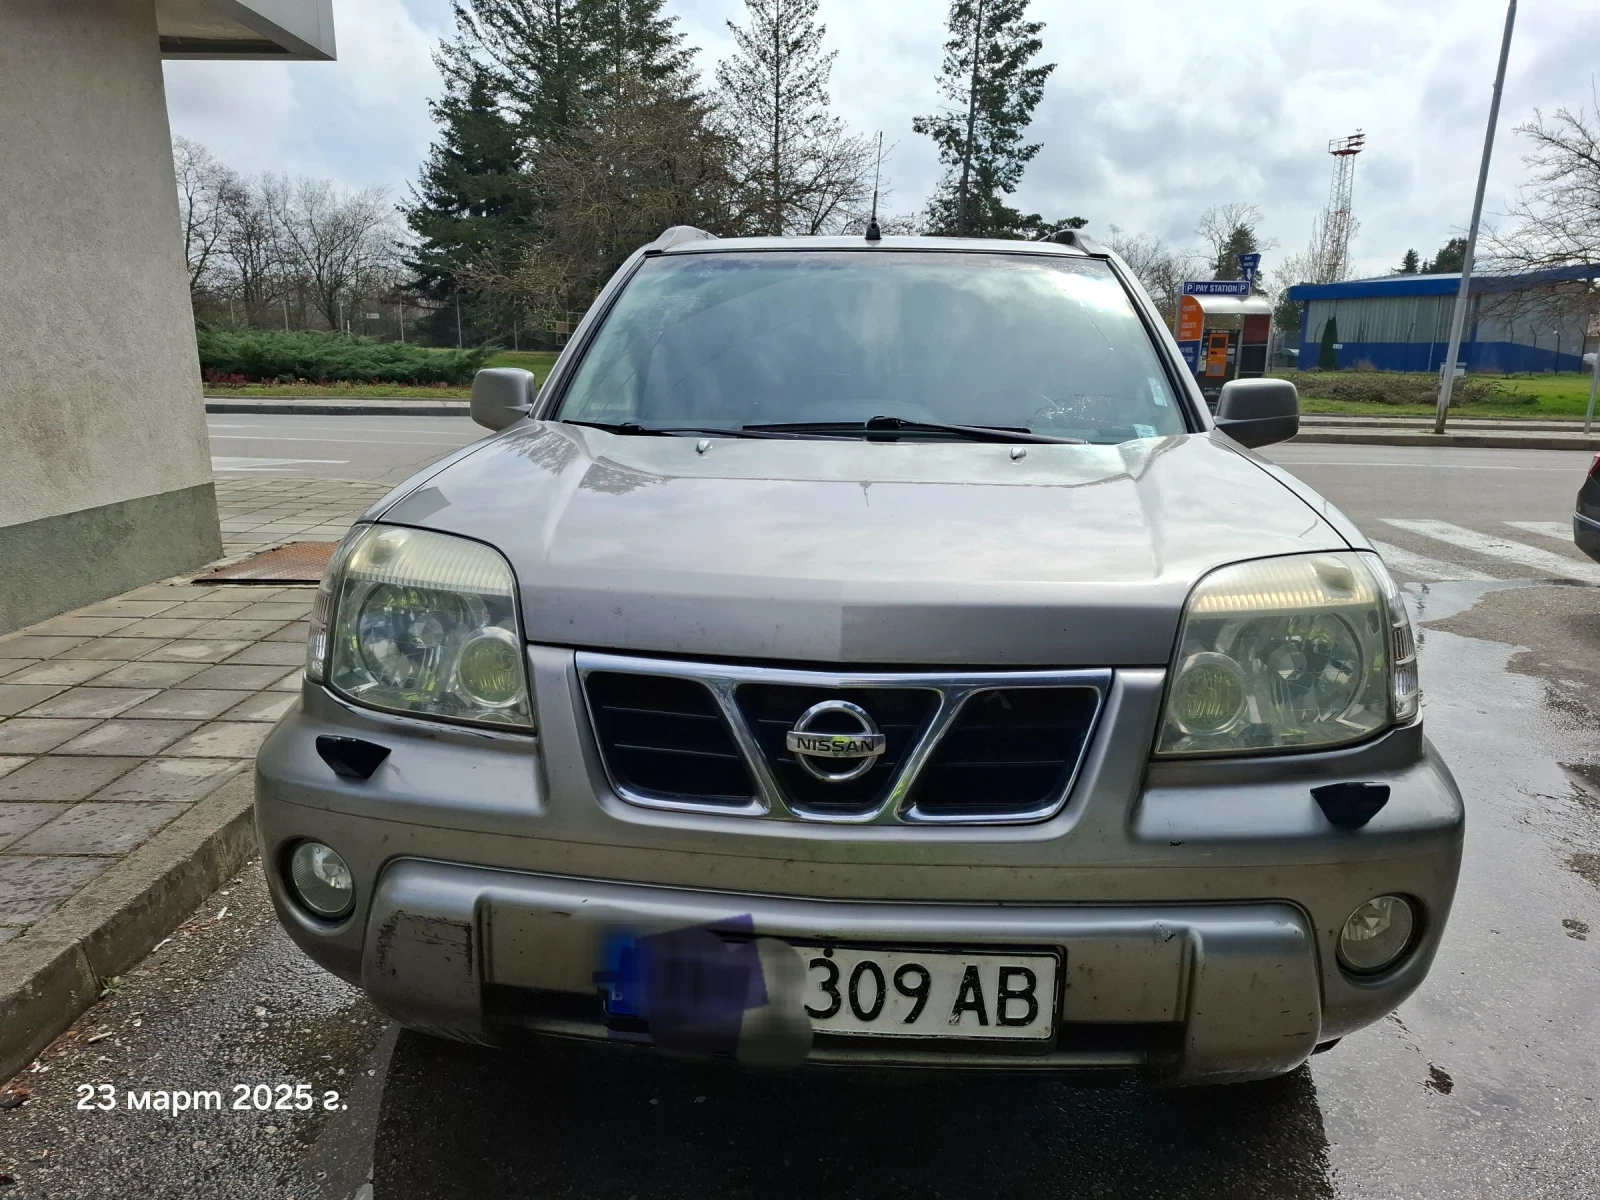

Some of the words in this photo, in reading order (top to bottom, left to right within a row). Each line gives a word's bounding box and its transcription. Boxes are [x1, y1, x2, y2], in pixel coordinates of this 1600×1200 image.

[1187, 284, 1193, 292] P
[1195, 284, 1208, 292] PAY
[1209, 284, 1238, 292] STATION
[1239, 285, 1246, 293] P
[797, 737, 875, 753] NISSAN
[803, 957, 931, 1024] 309
[948, 964, 1038, 1026] AB
